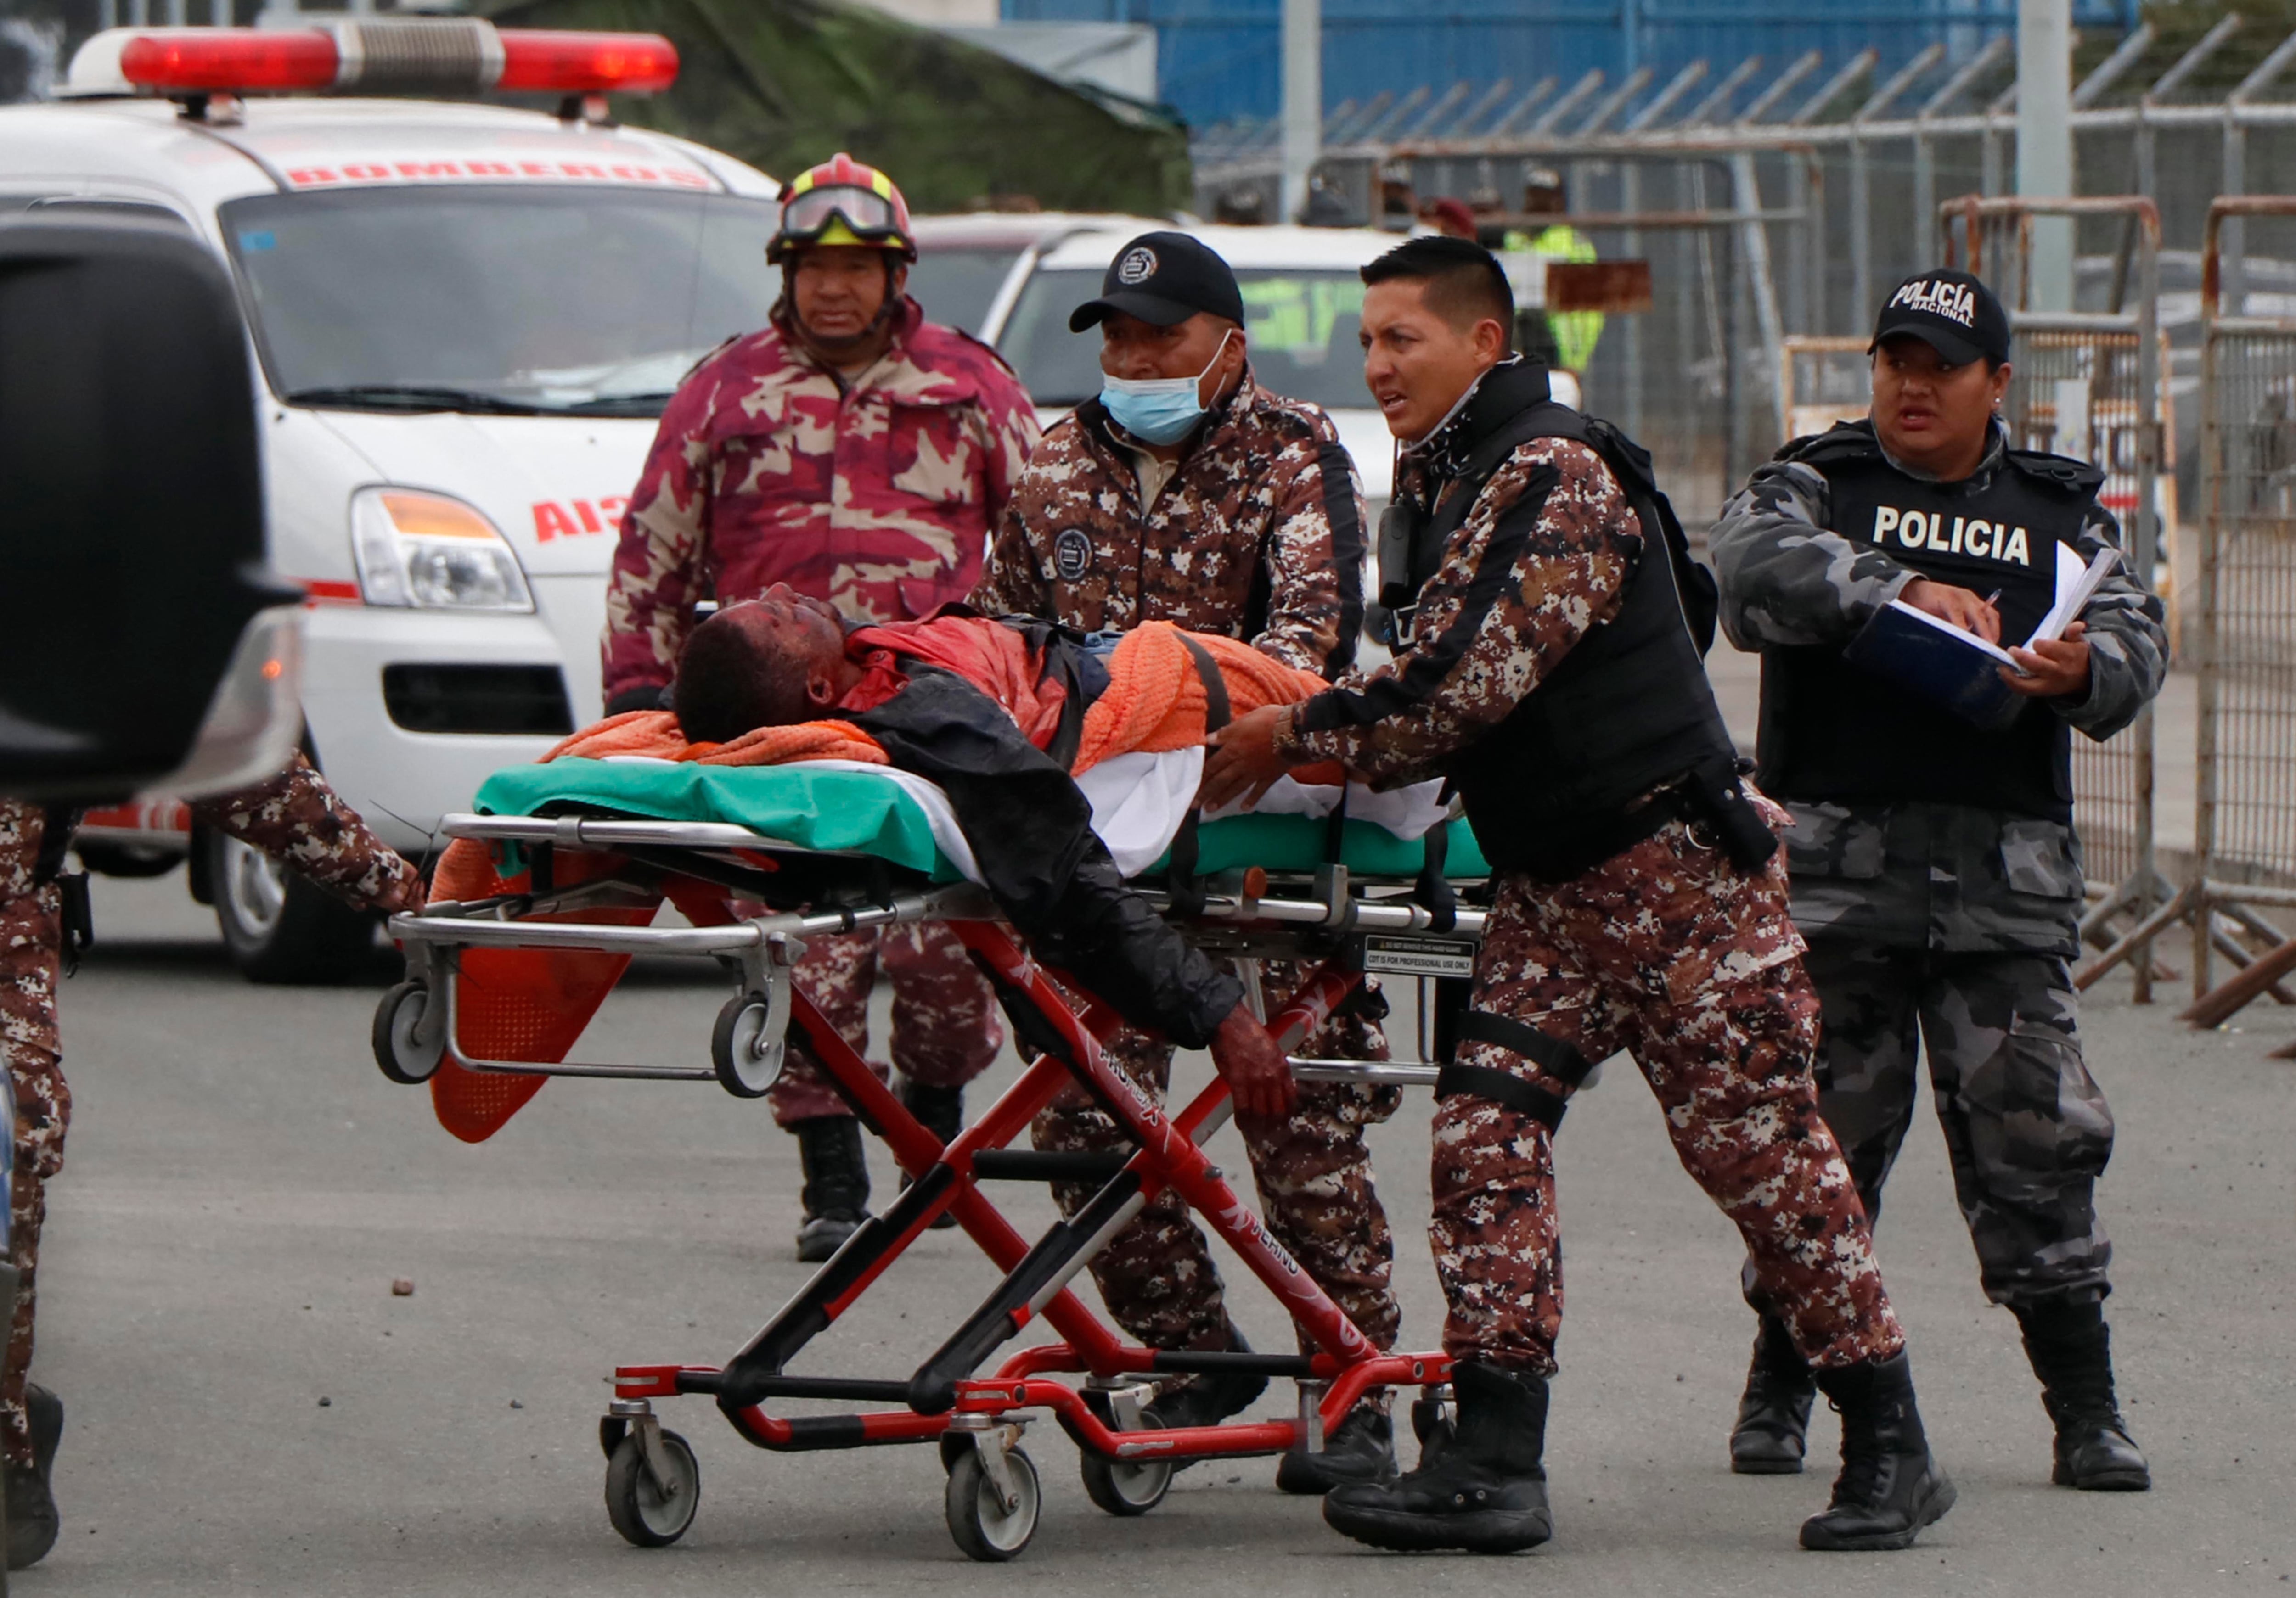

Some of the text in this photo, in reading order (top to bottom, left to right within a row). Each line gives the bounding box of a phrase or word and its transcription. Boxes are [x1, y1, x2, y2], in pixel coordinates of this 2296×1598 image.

[286, 160, 710, 187] BOMBEROS
[1910, 300, 1973, 328] NACIONAL
[1873, 505, 2030, 566] POLICIA
[1400, 957, 1441, 968] PROFESSIONAL
[1443, 960, 1453, 968] USE
[1455, 960, 1469, 969] ONLY
